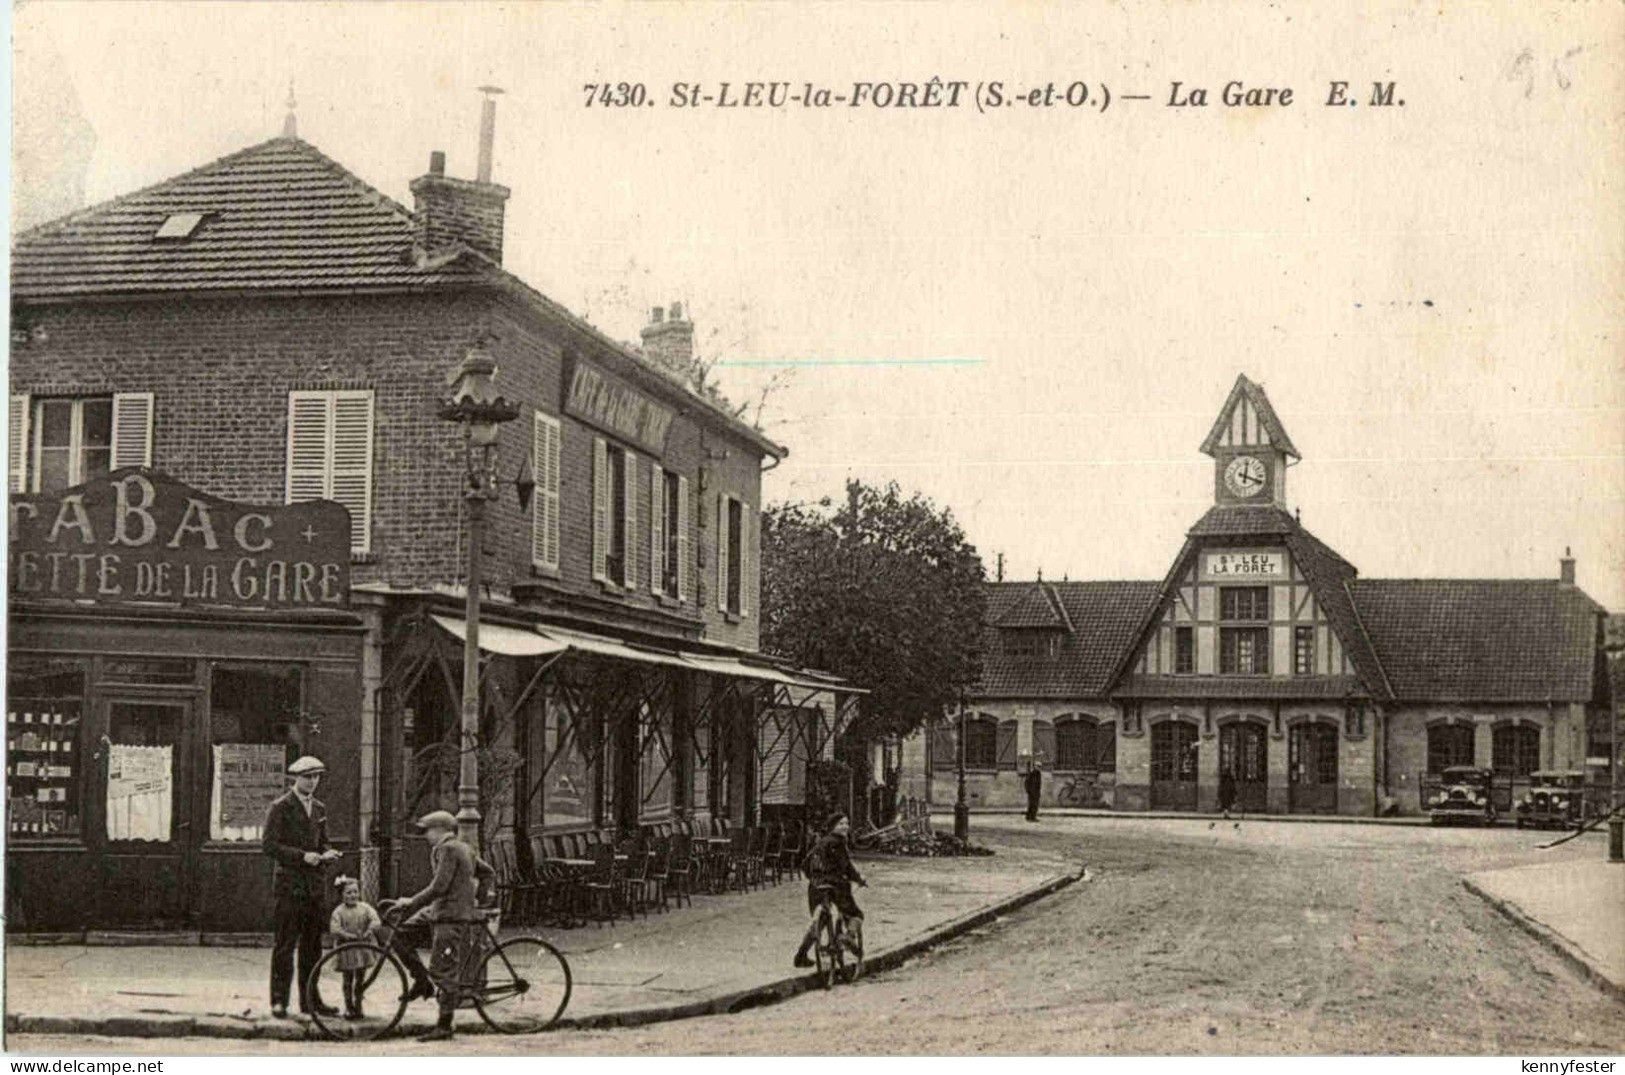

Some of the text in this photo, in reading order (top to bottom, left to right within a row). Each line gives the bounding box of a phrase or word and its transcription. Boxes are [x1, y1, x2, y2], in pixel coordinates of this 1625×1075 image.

[1242, 554, 1269, 564] LEU
[1213, 564, 1228, 574] LA
[8, 551, 341, 602] ETTE DE LA GARE
